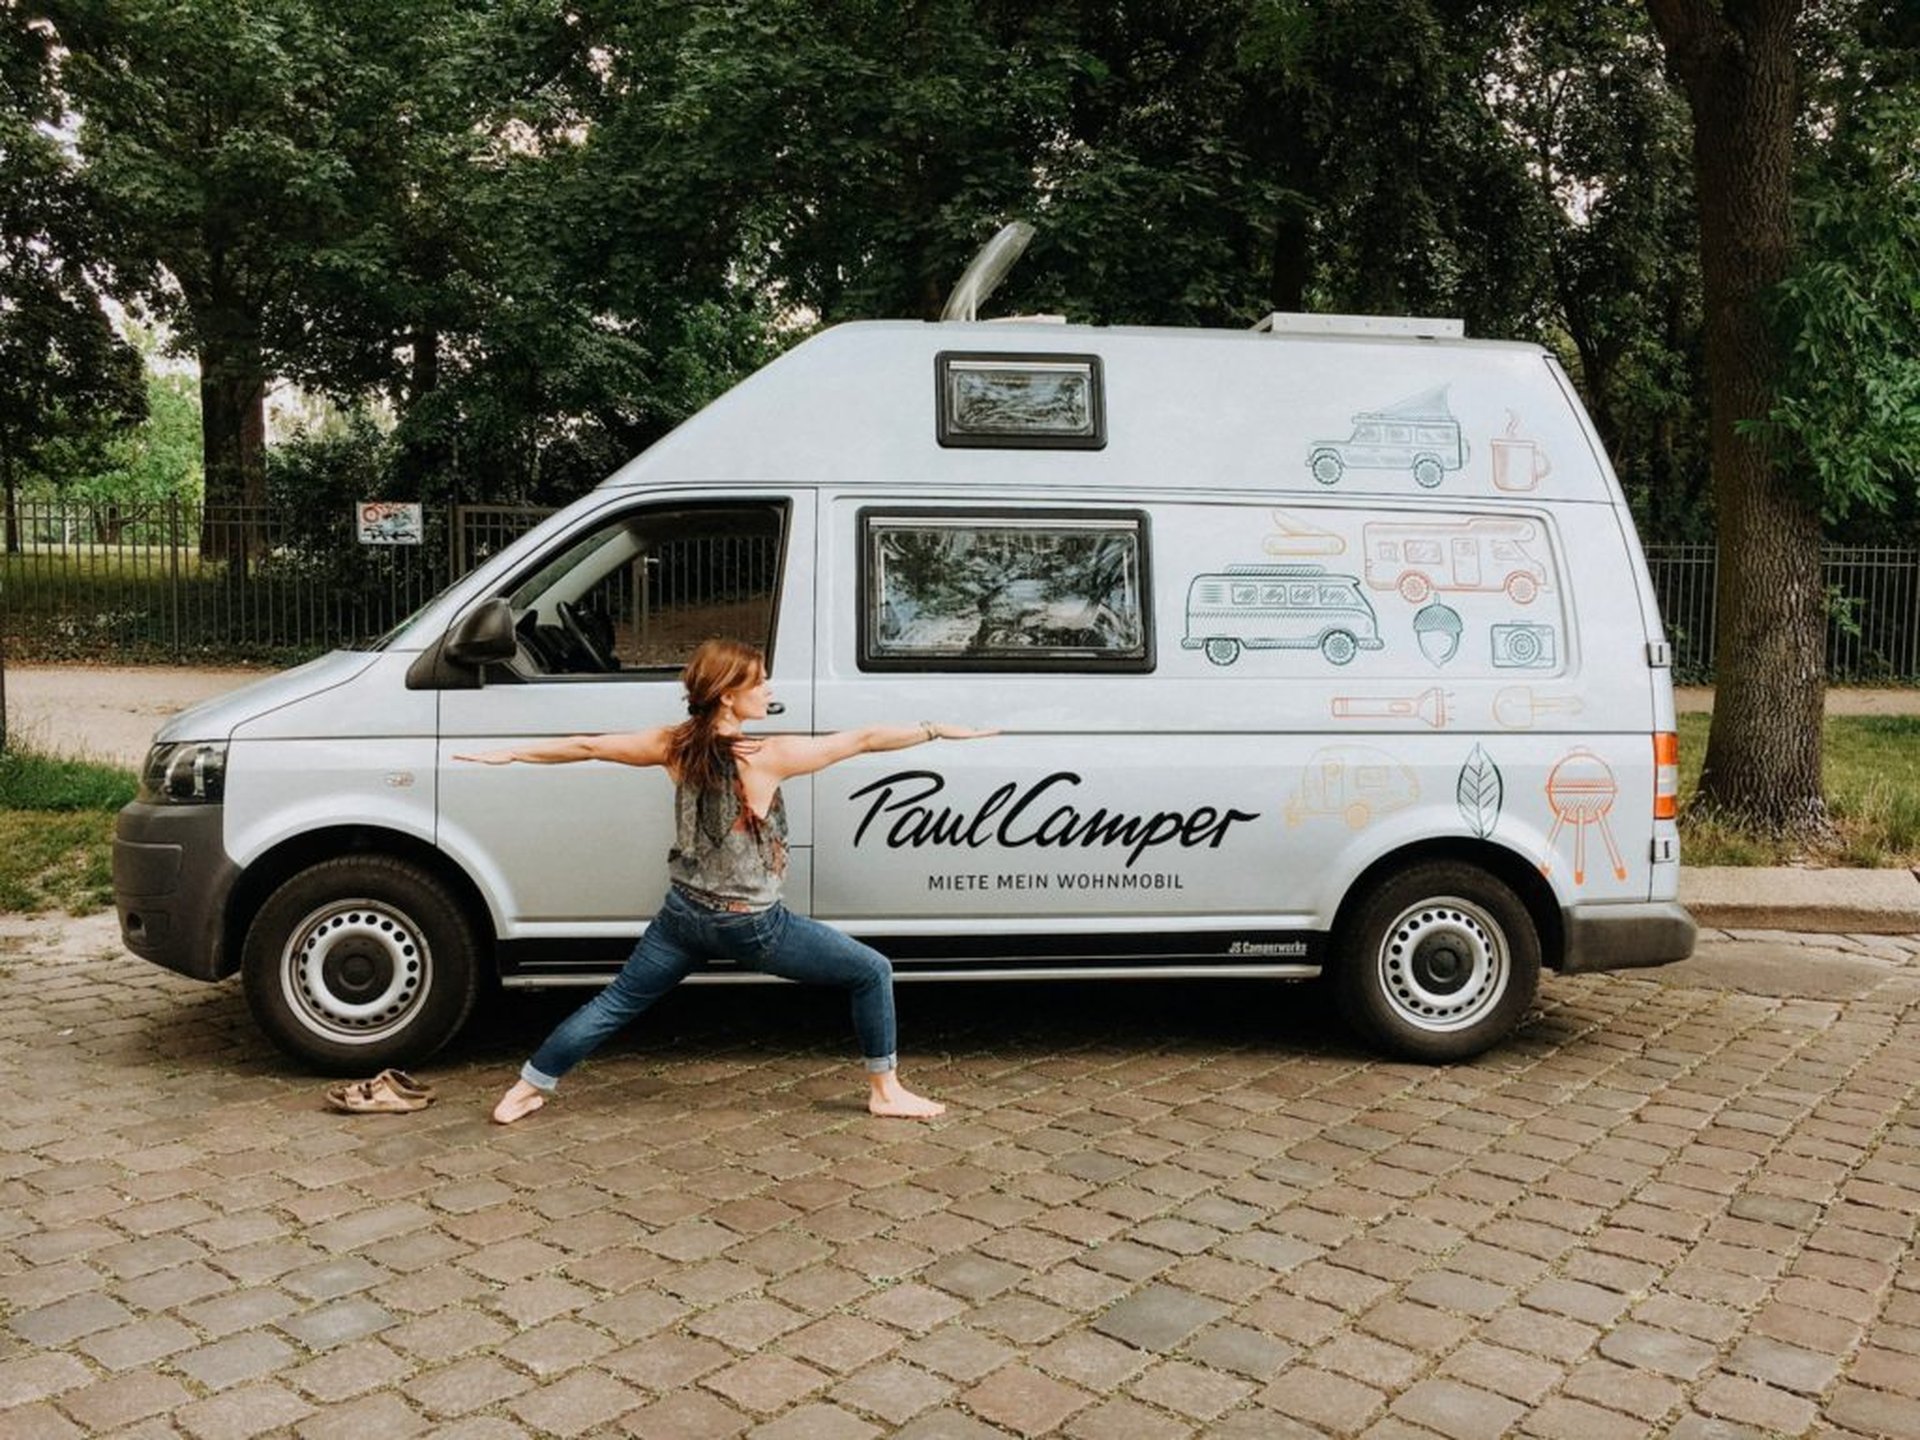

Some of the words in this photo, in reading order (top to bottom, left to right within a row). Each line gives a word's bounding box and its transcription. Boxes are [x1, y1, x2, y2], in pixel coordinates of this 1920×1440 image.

[849, 770, 1261, 868] PaulCamper
[928, 874, 990, 891] MIETE
[997, 873, 1048, 890] MEIN
[1057, 873, 1184, 889] WOHNMOBIL
[1228, 941, 1242, 954] JS
